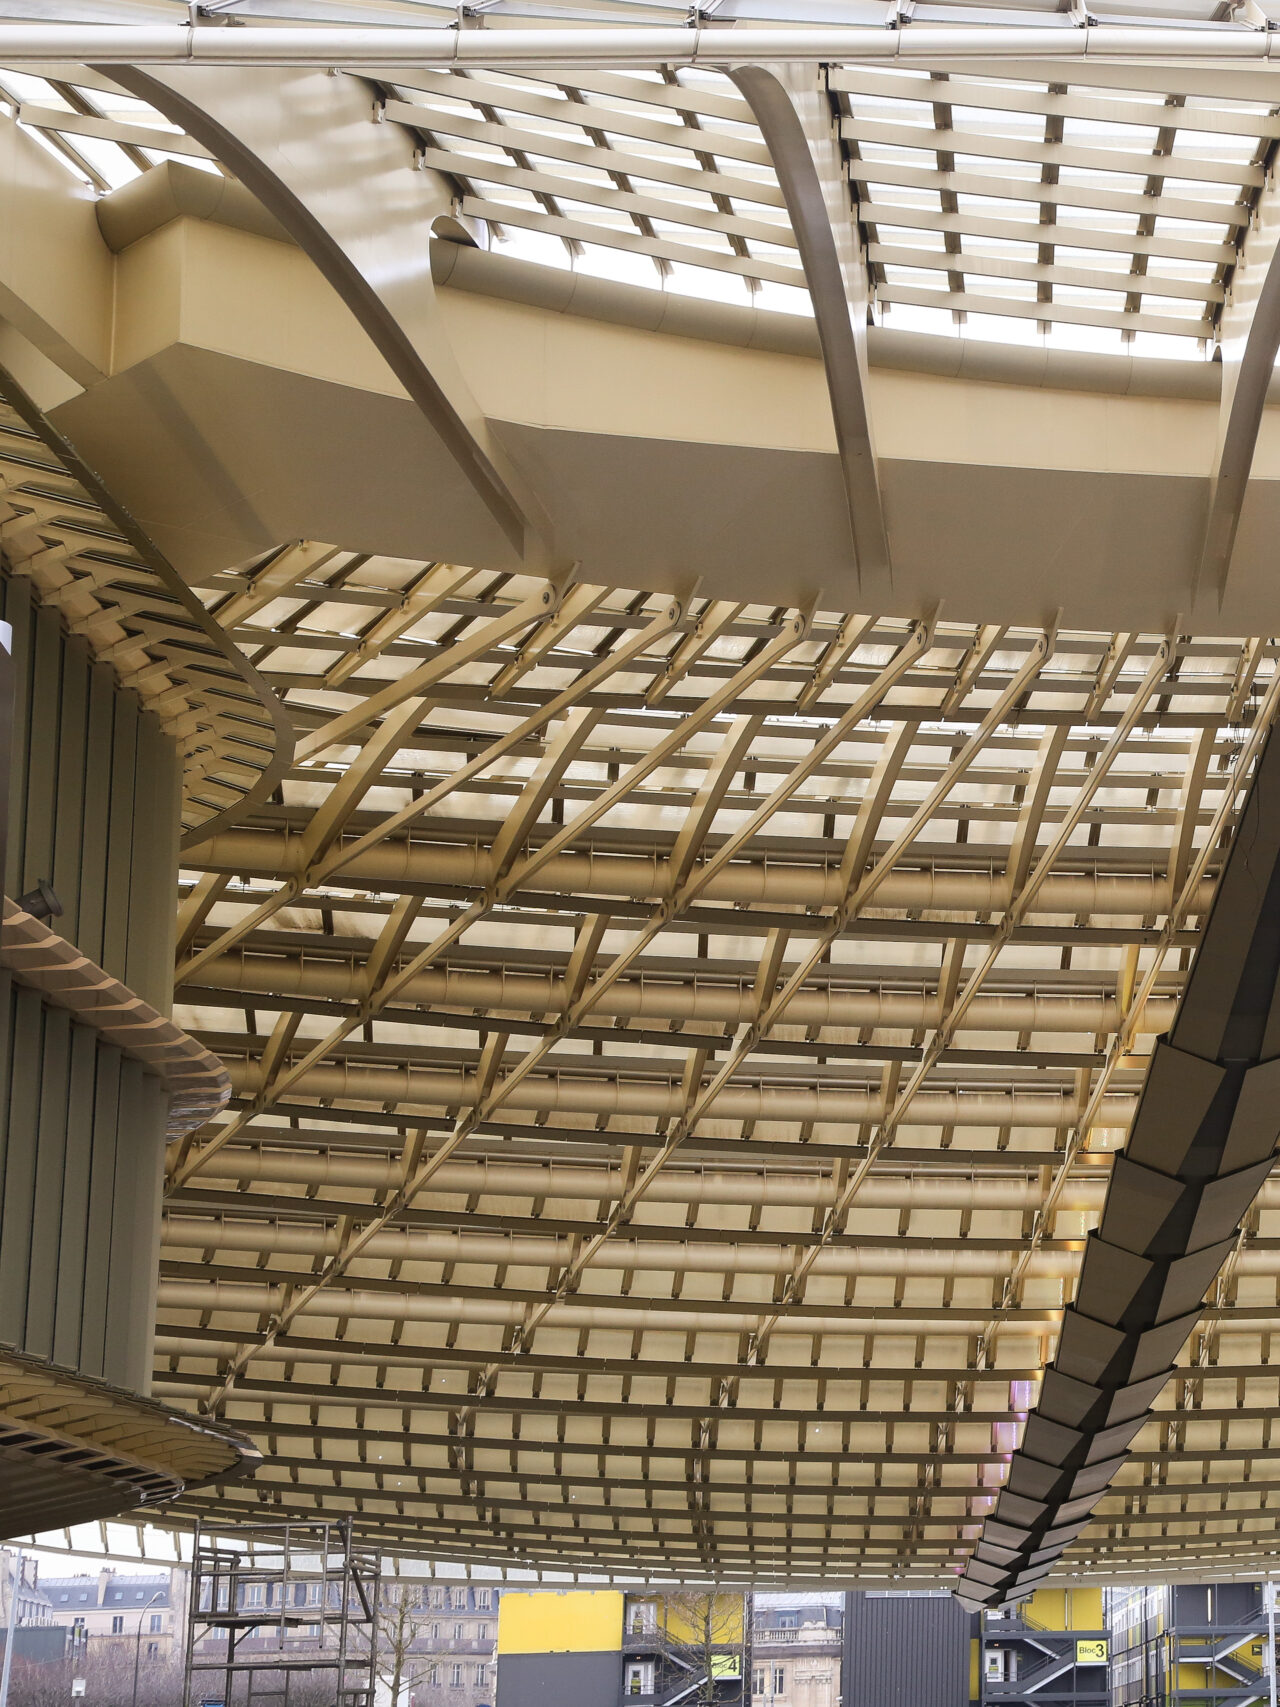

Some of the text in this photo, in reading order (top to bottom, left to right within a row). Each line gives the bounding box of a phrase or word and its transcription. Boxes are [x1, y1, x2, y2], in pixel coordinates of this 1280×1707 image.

[1079, 1643, 1104, 1658] Bloc 3
[728, 1659, 738, 1672] 4
